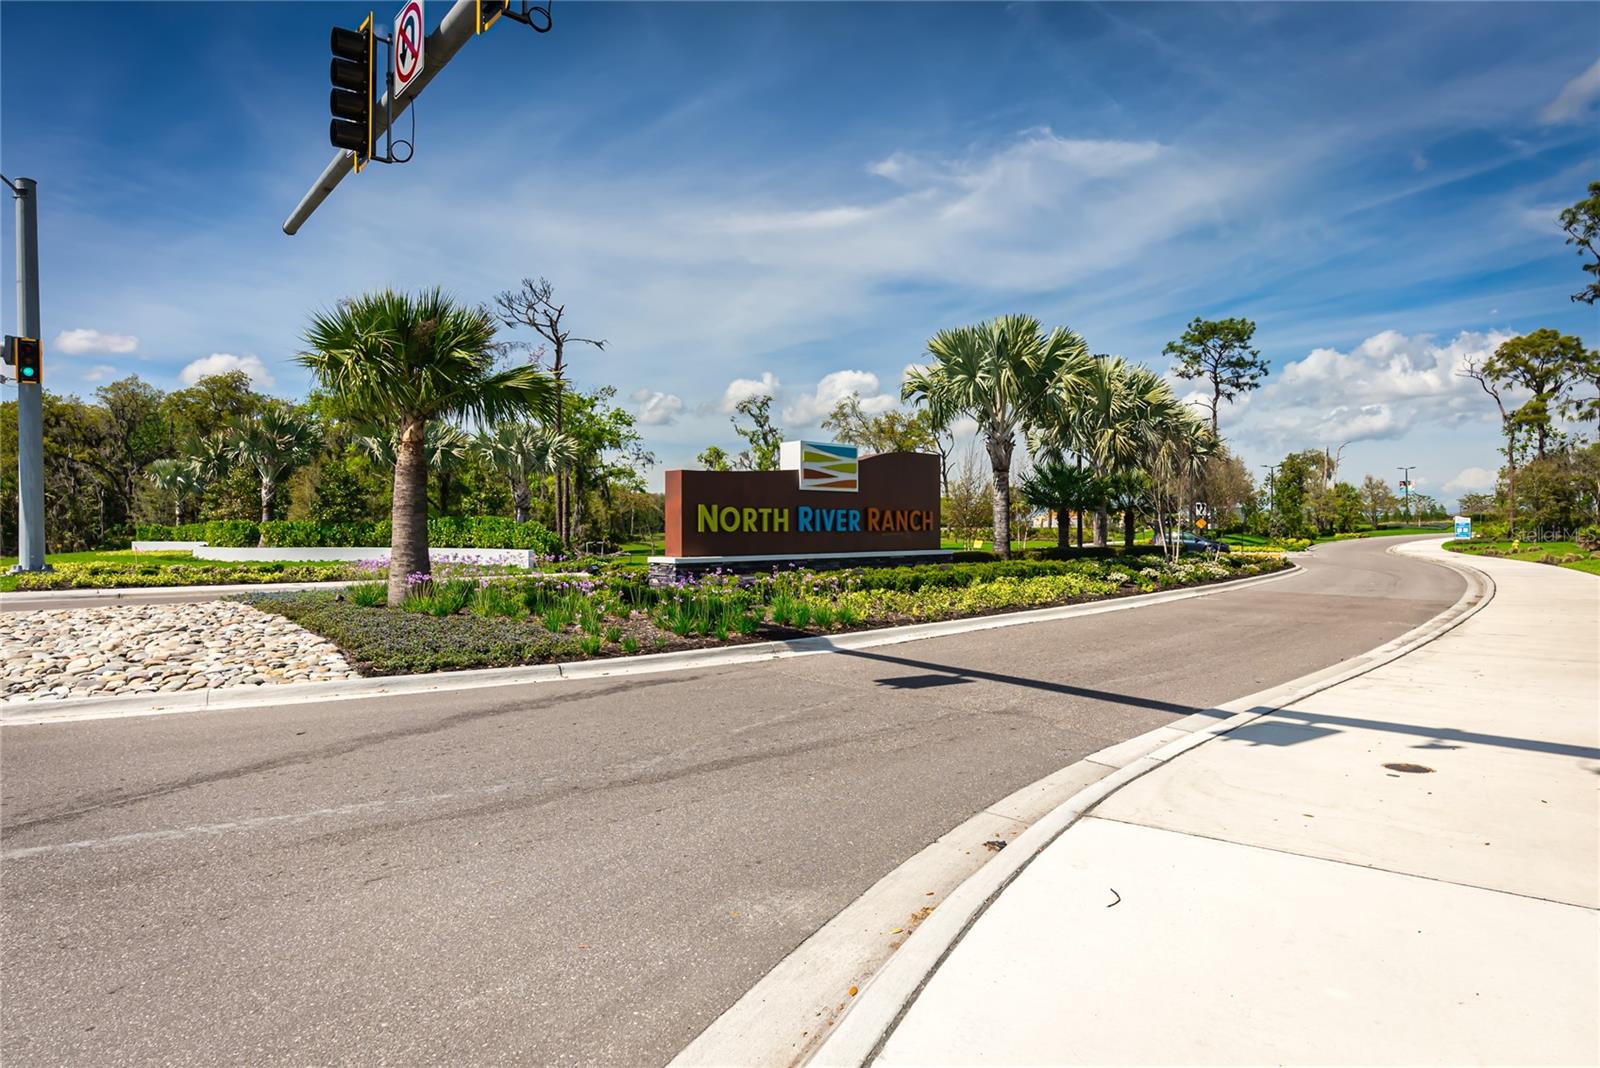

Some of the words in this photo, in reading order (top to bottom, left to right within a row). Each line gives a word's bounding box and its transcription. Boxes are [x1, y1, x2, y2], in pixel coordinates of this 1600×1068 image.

[697, 504, 790, 533] NORTH
[797, 506, 861, 532] RIVER
[867, 507, 934, 532] RANCH
